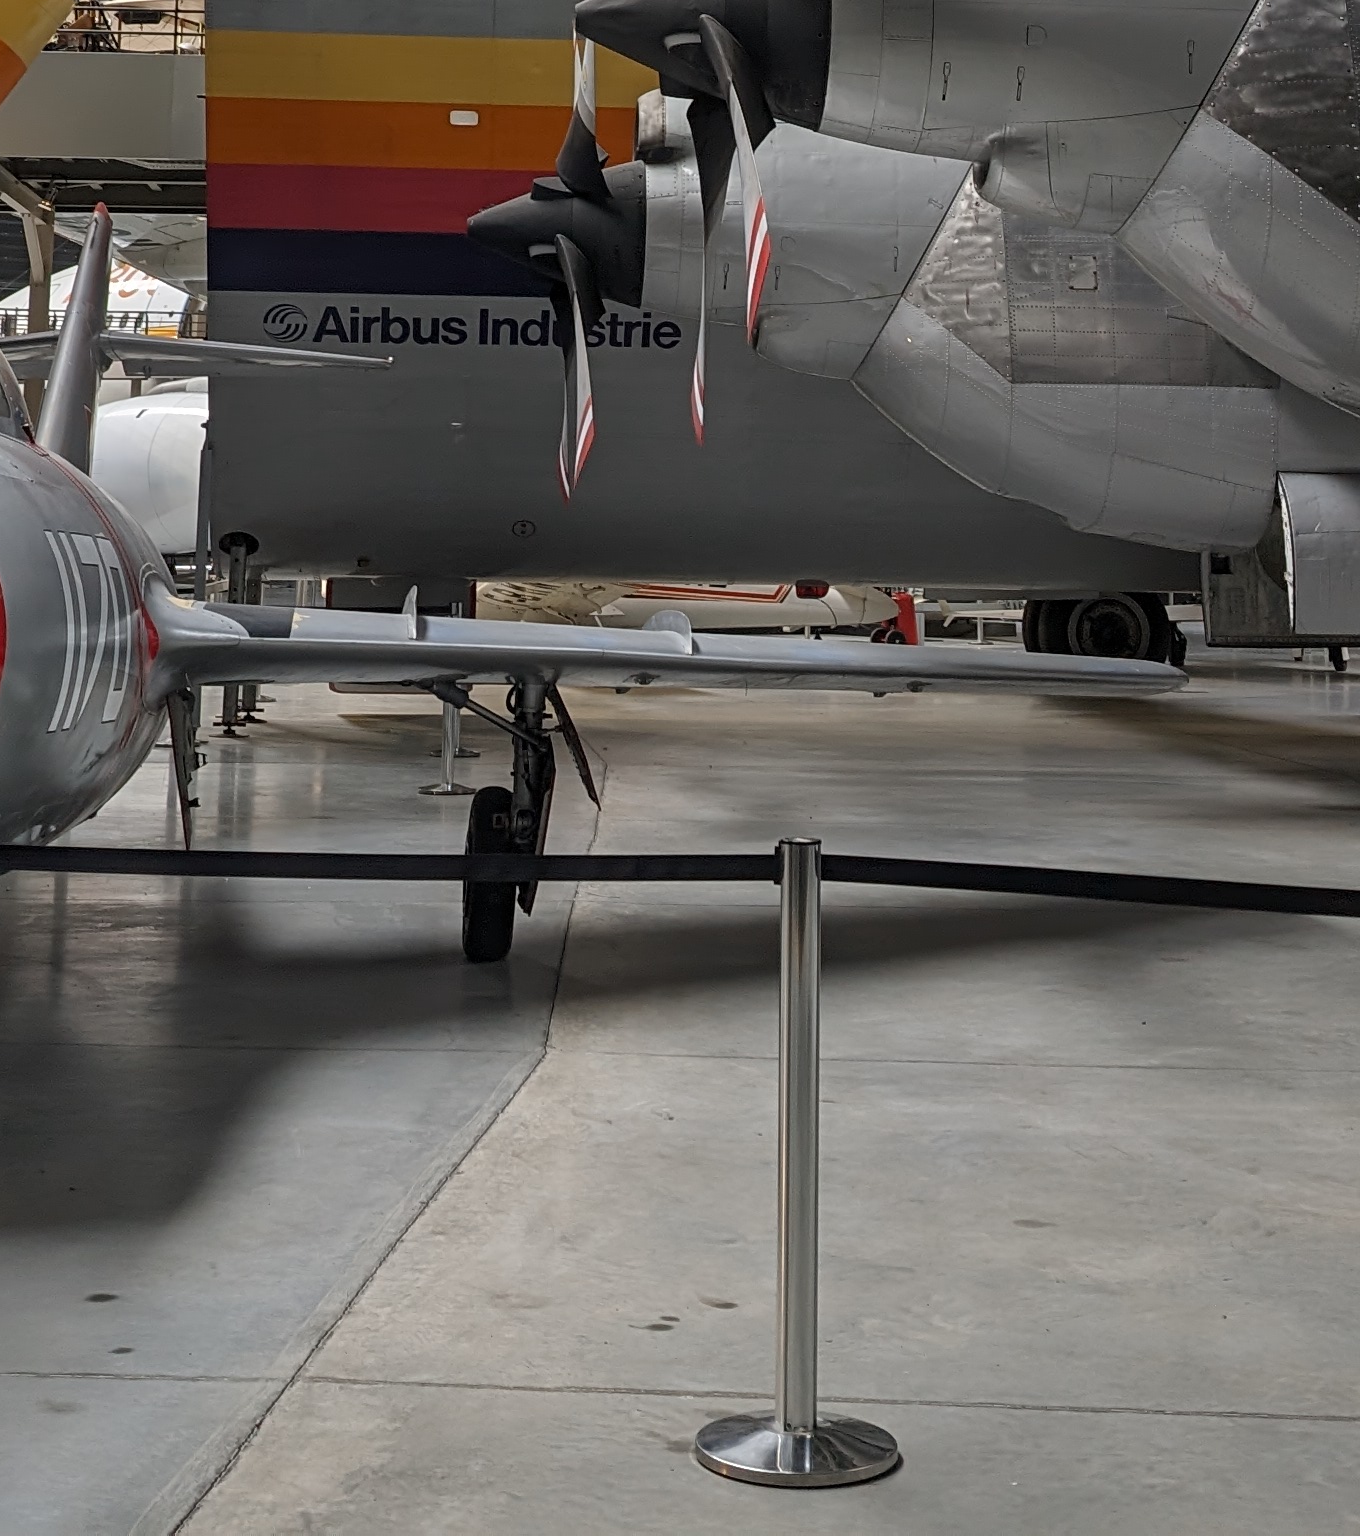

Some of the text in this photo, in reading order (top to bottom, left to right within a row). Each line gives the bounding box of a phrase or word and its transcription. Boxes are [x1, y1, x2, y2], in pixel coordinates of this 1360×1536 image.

[312, 306, 682, 349] Airbus Indstrie
[43, 529, 132, 734] 1170
